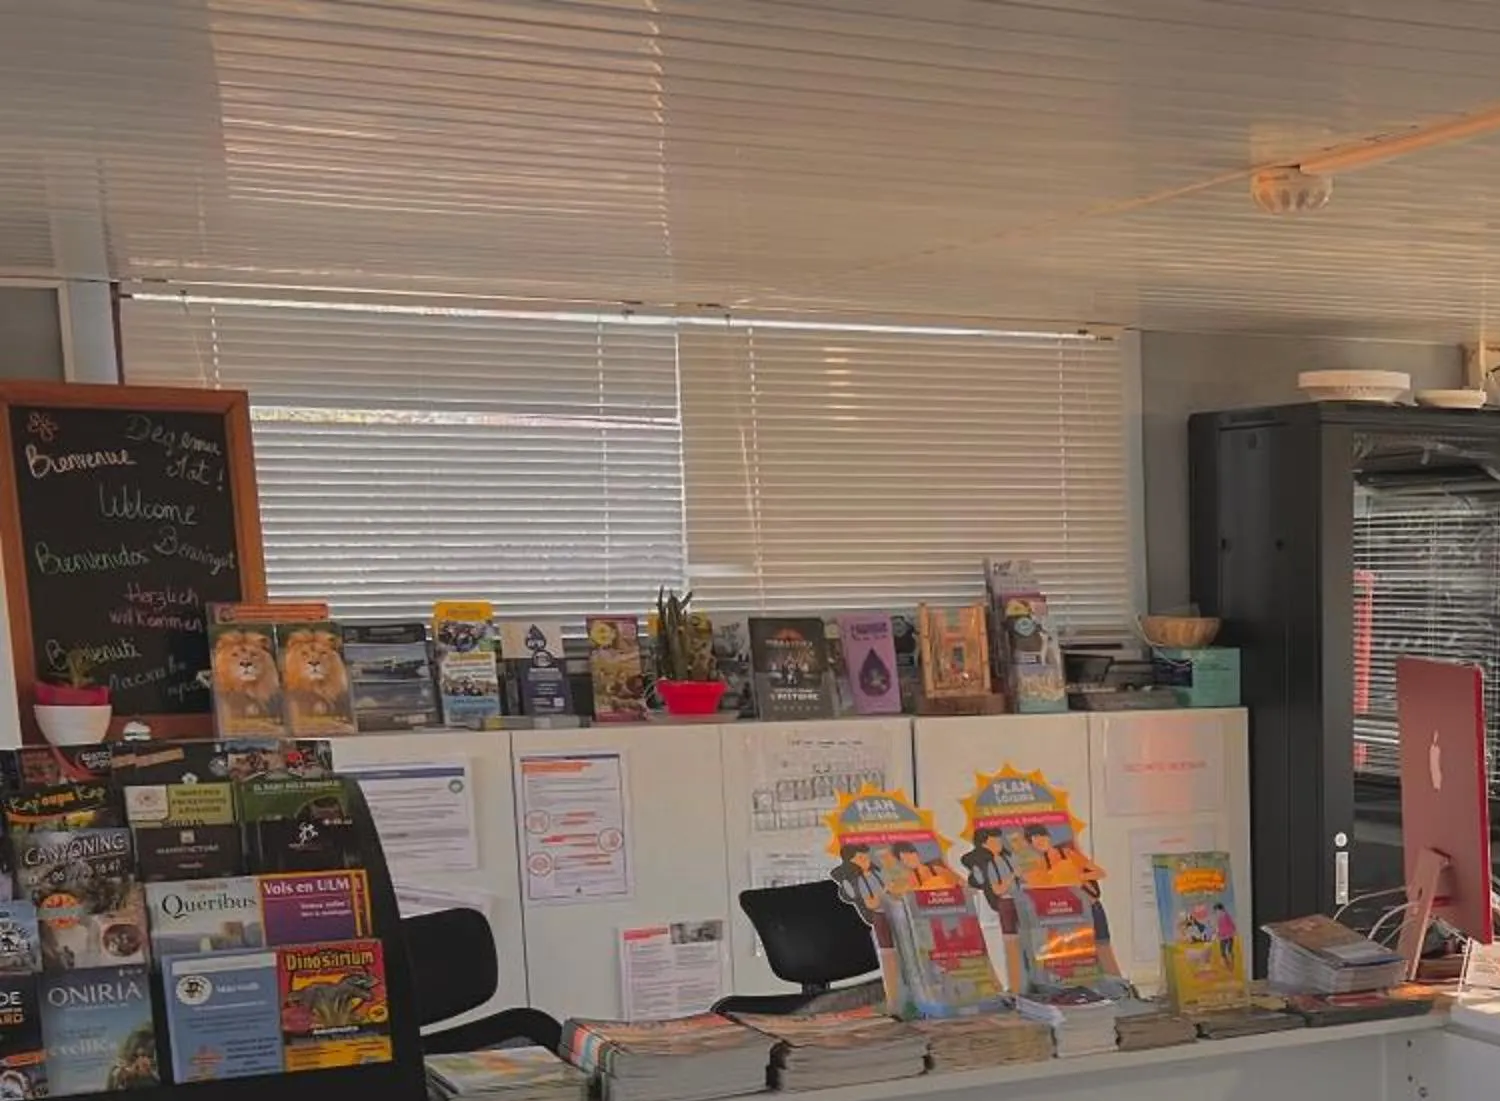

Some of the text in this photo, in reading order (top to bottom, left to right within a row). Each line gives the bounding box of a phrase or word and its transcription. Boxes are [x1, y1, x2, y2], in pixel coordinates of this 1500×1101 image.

[25, 447, 138, 479] Bienvenue
[99, 481, 198, 526] Welcome
[24, 832, 125, 866] CANYONING
[263, 878, 350, 895] Vols en ULM
[47, 980, 142, 1008] ONIRIA
